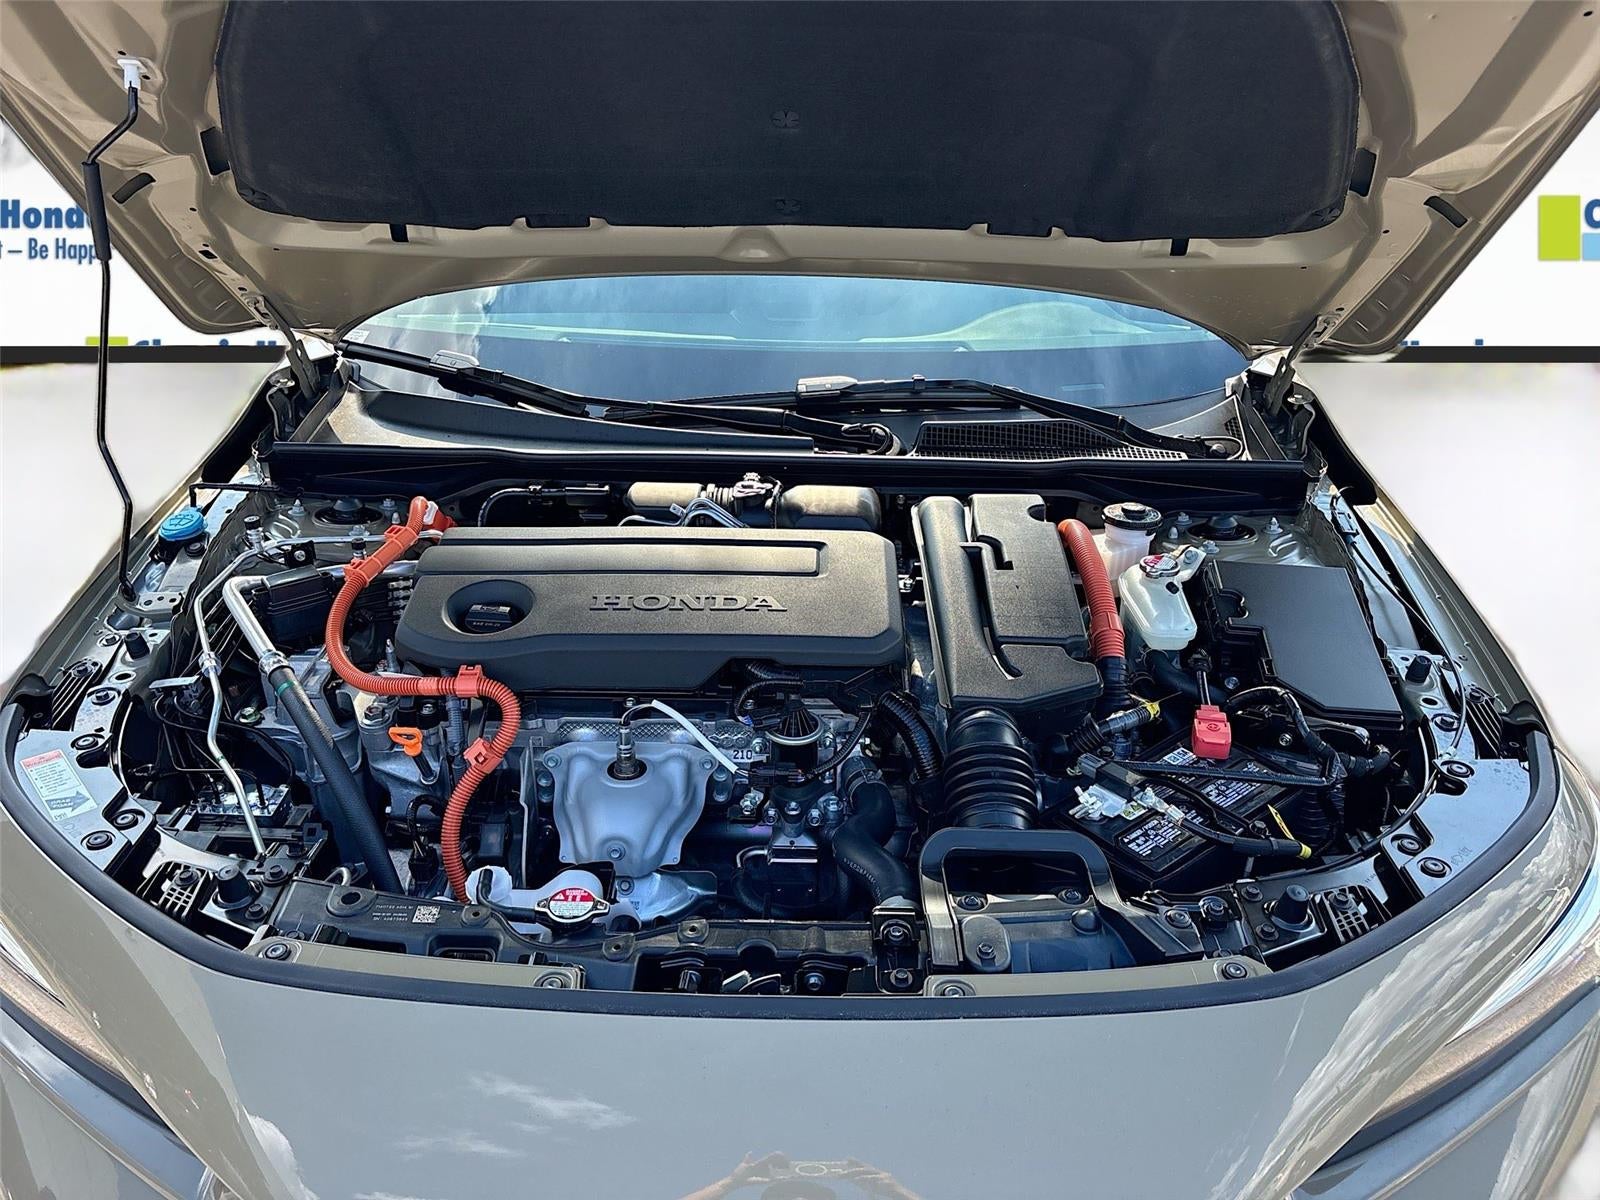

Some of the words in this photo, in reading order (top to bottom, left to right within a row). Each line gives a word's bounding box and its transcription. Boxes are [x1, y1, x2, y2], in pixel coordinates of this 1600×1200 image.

[0, 199, 91, 229] Hond
[28, 237, 49, 260] Be
[55, 237, 97, 265] Happ
[589, 594, 788, 612] HONDA
[732, 749, 753, 760] 210
